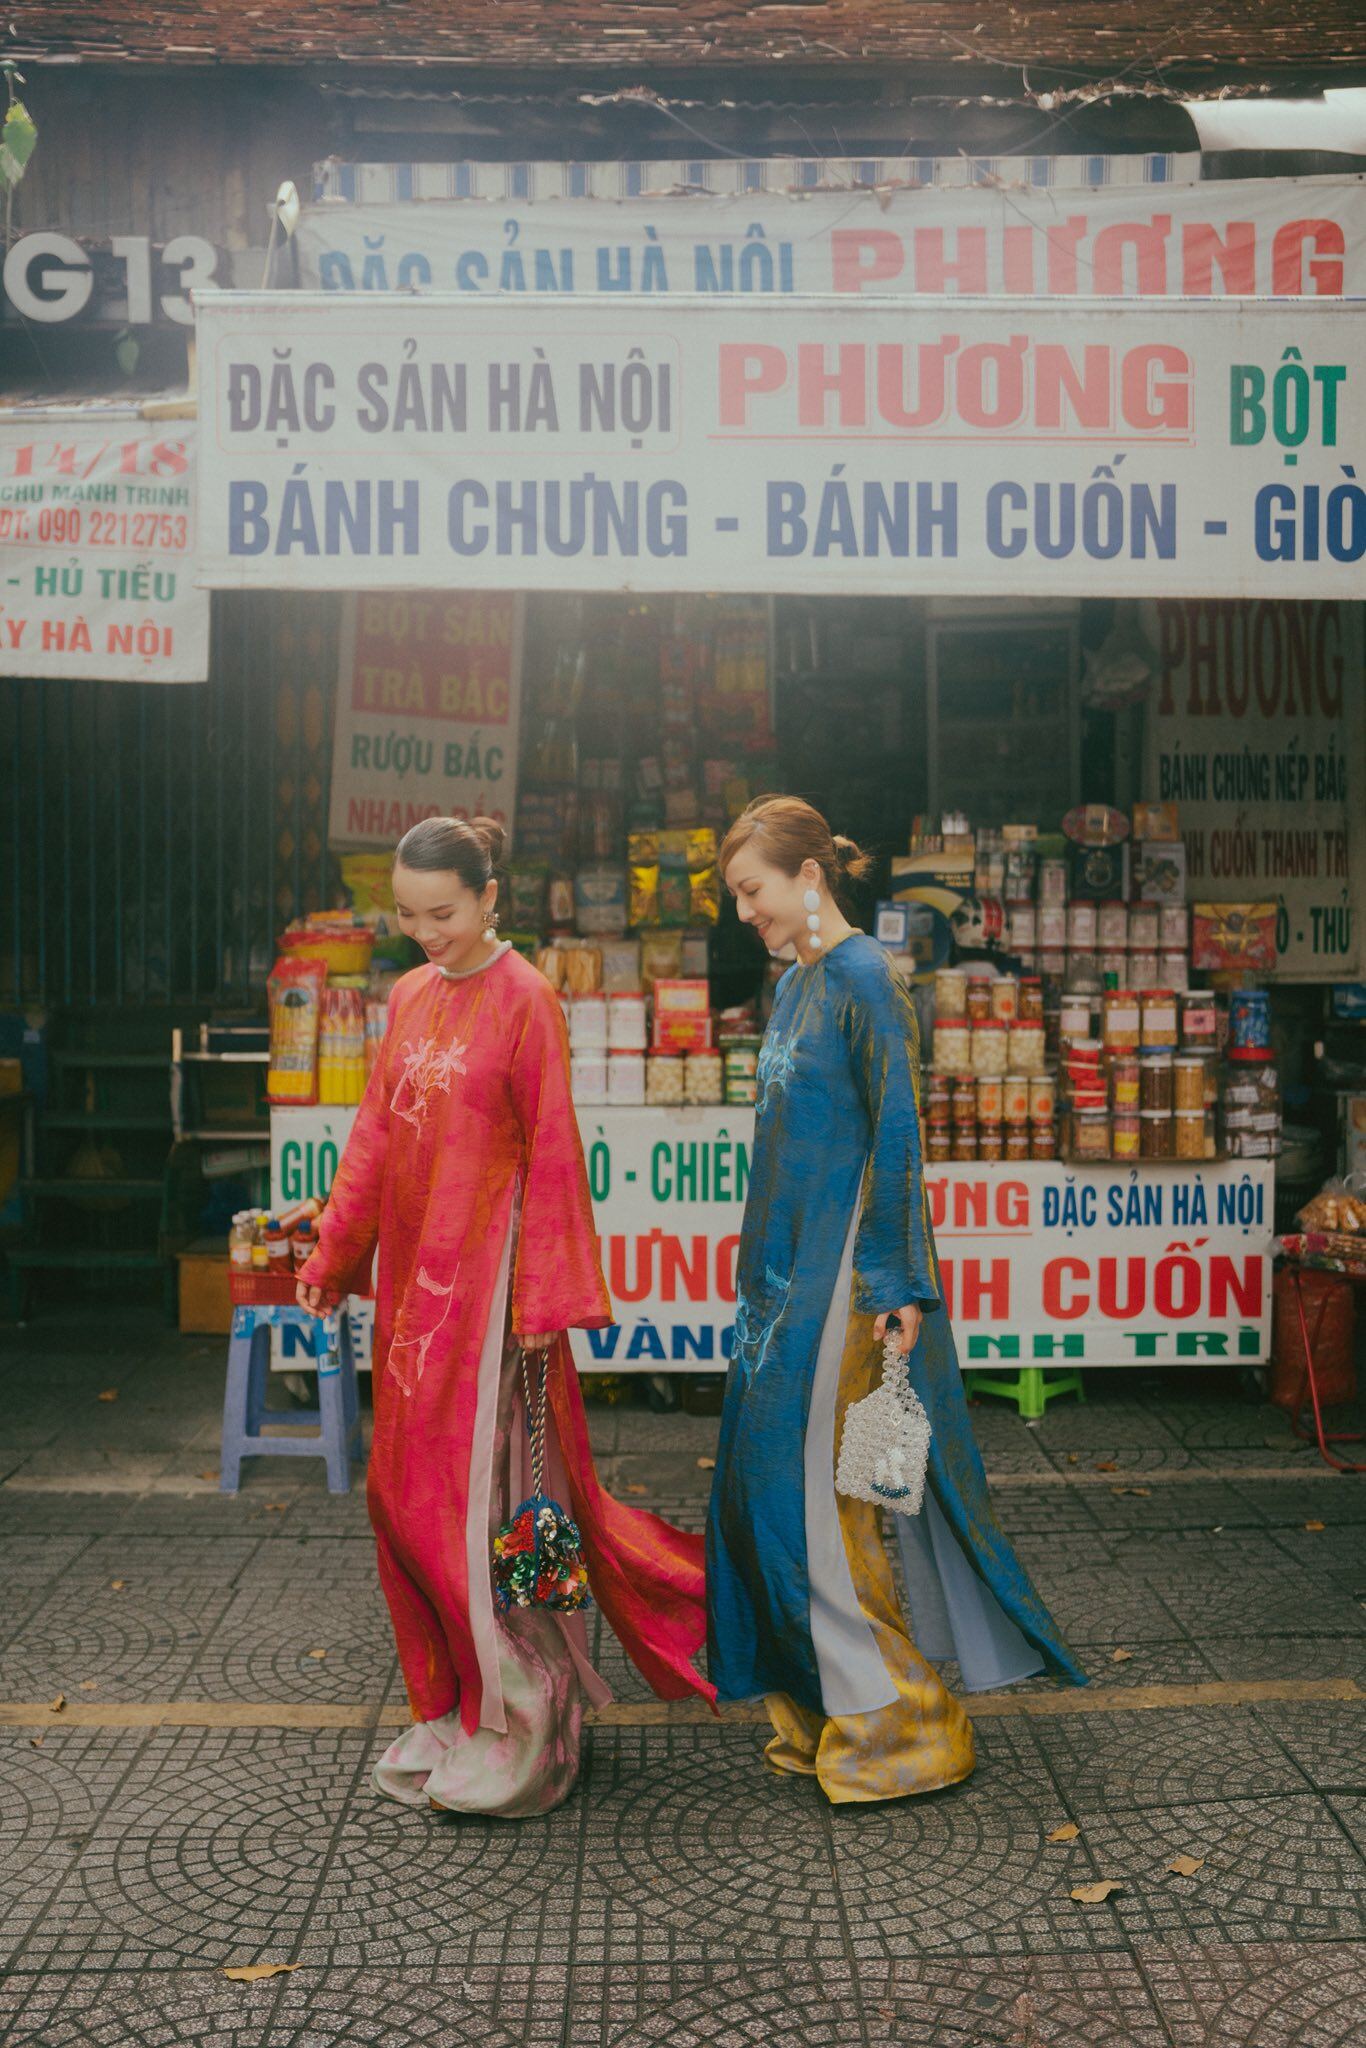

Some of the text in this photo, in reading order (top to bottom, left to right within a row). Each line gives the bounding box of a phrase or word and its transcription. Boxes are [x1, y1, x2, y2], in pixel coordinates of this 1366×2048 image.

[227, 334, 1346, 466] ĐẶC SẢN HÀ NỘI PHƯƠNG BỘT
[39, 508, 81, 543] 090
[88, 512, 188, 549] 2212753
[228, 463, 420, 557] BÁNH
[447, 472, 688, 558] CHƯNG
[766, 464, 958, 558] BÁNH
[986, 454, 1177, 560] CUỐN
[1254, 466, 1366, 562] GIÒ
[35, 557, 83, 597] HỦ
[97, 560, 176, 602] TIẾU
[42, 615, 93, 653] HÀ
[108, 618, 173, 664] NỘI
[1160, 740, 1207, 801] BÁNH
[1262, 829, 1318, 878] THANH
[1043, 1178, 1096, 1236] ĐẶC
[1107, 1169, 1162, 1226] SẢN
[1172, 1173, 1207, 1226] HÀ
[1218, 1174, 1263, 1235] NỘI
[1042, 1238, 1262, 1319] CUỐN
[1123, 1325, 1260, 1357] TRÌ
